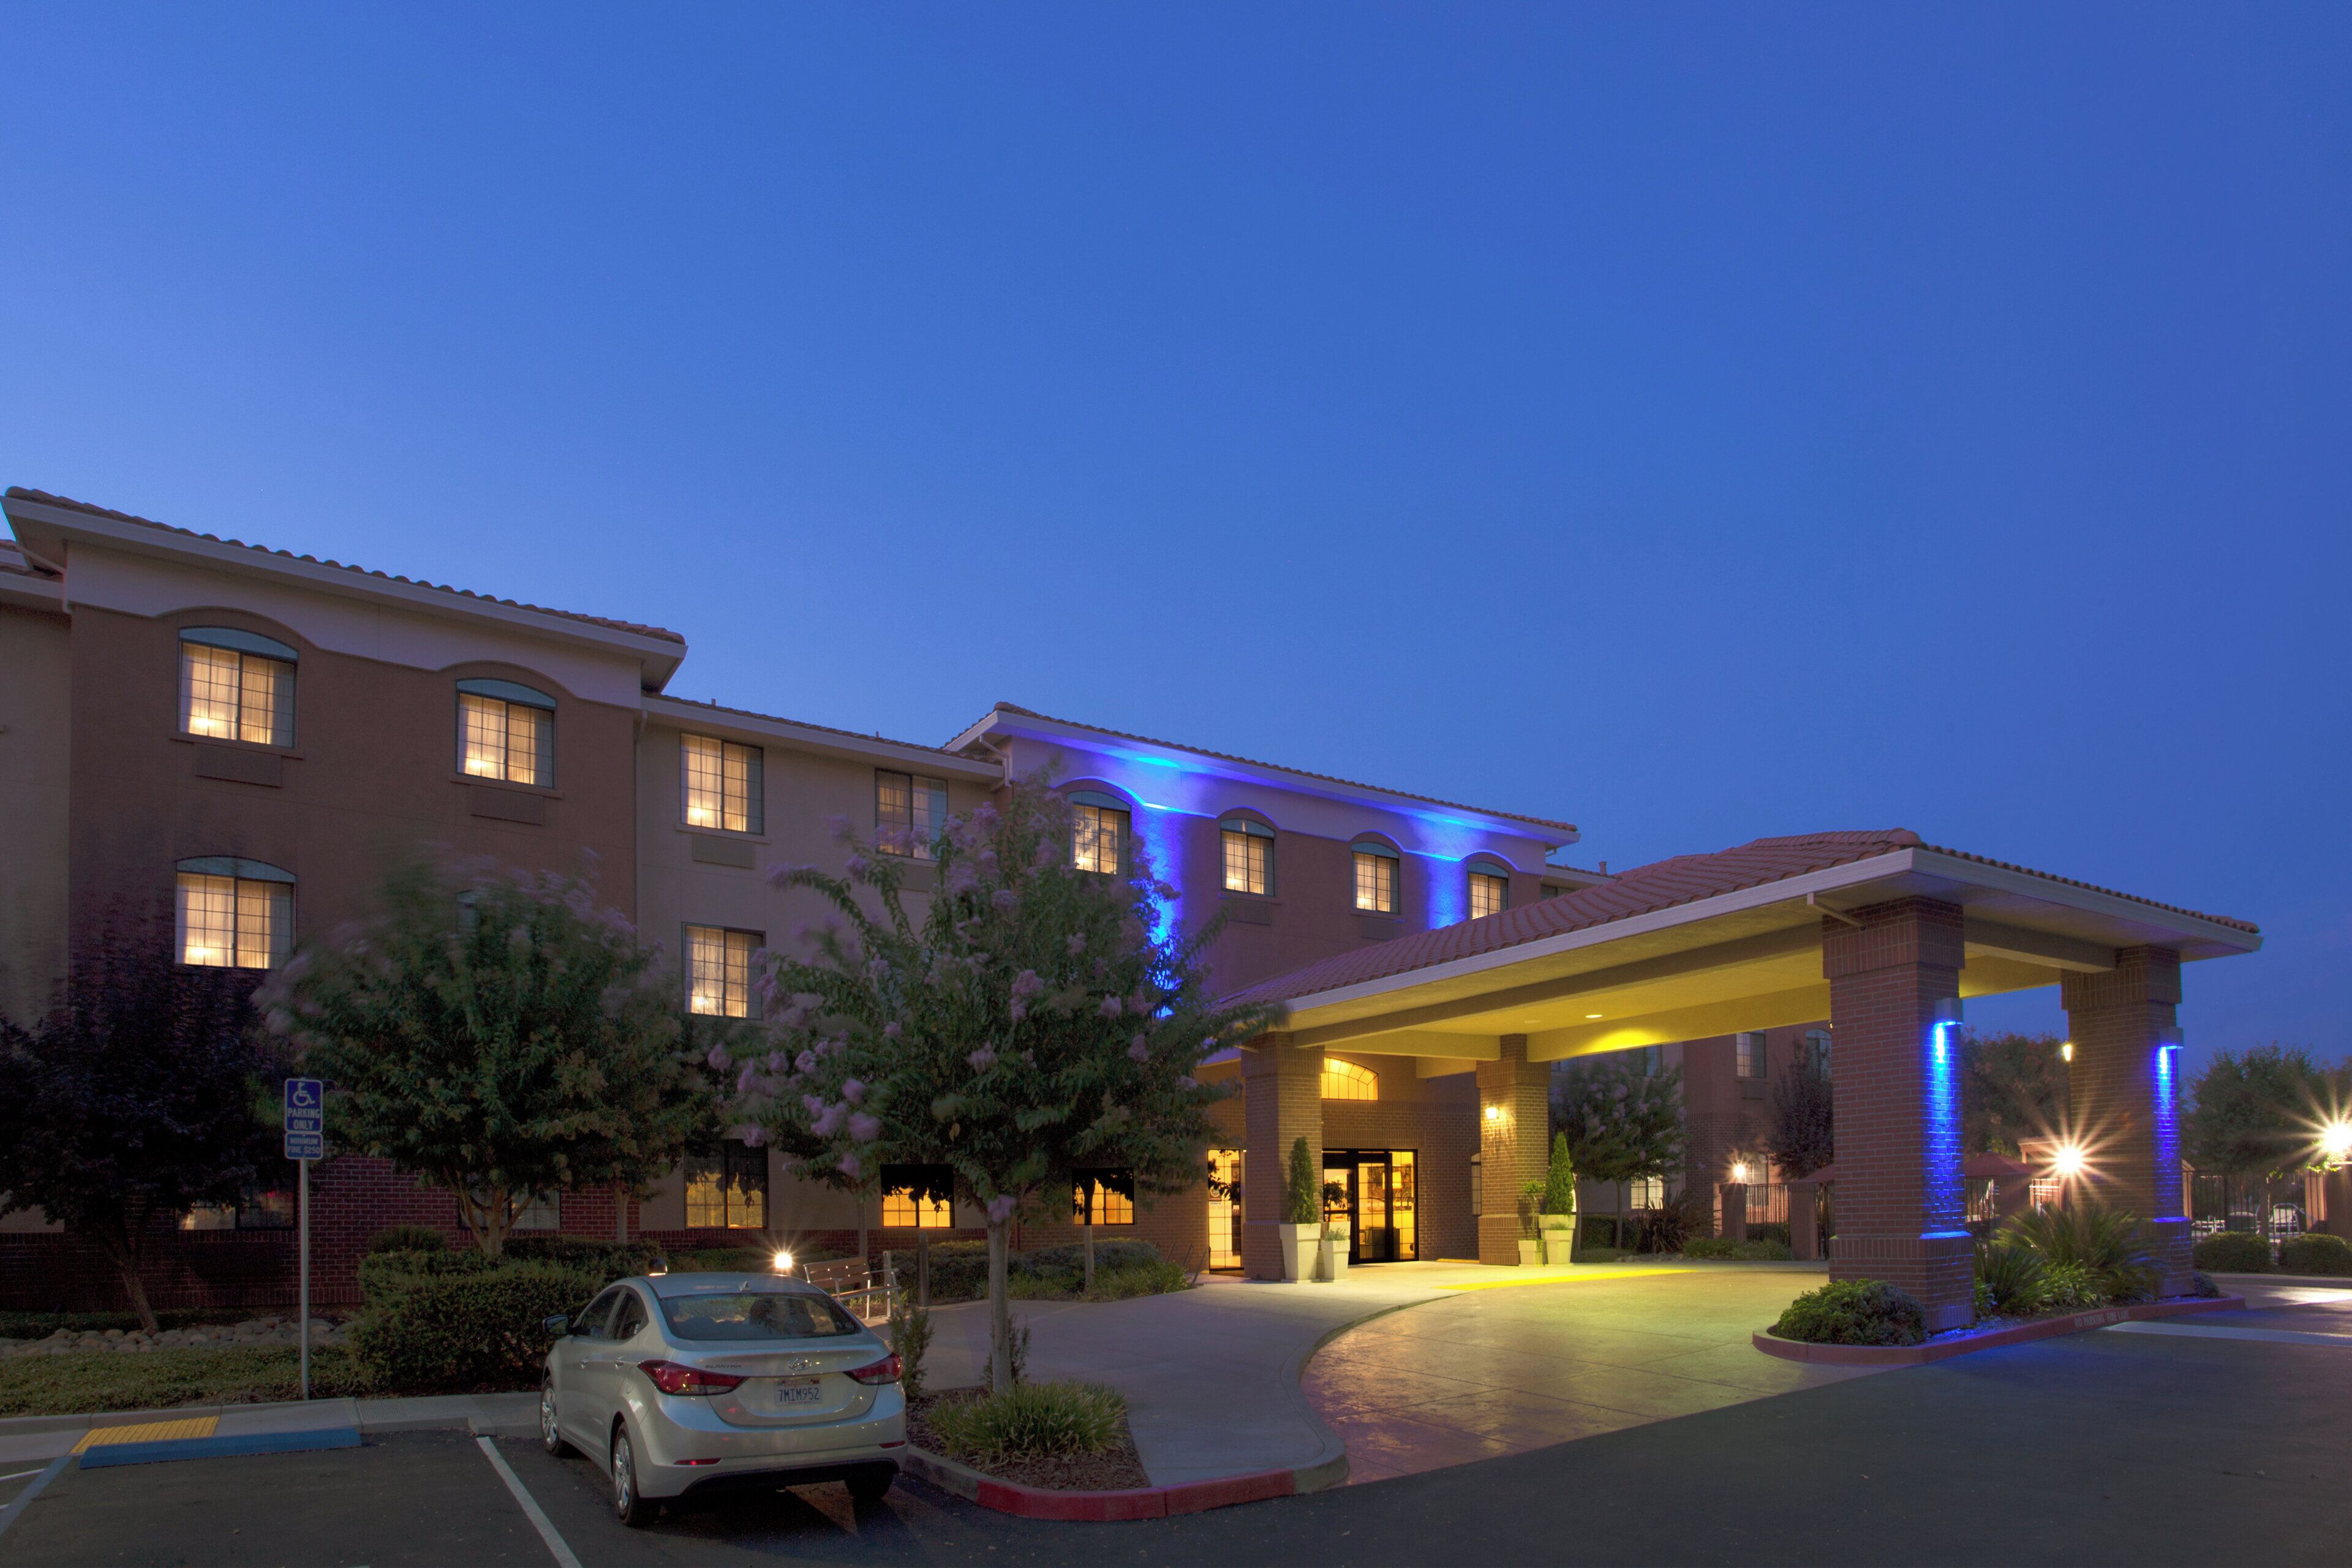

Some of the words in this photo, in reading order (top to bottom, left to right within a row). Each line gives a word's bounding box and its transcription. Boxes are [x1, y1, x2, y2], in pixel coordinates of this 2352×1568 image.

[288, 1107, 320, 1118] PARKING
[293, 1120, 314, 1129] ONLY
[2083, 1313, 2105, 1326] PARKING
[777, 1387, 820, 1402] 7MIM952
